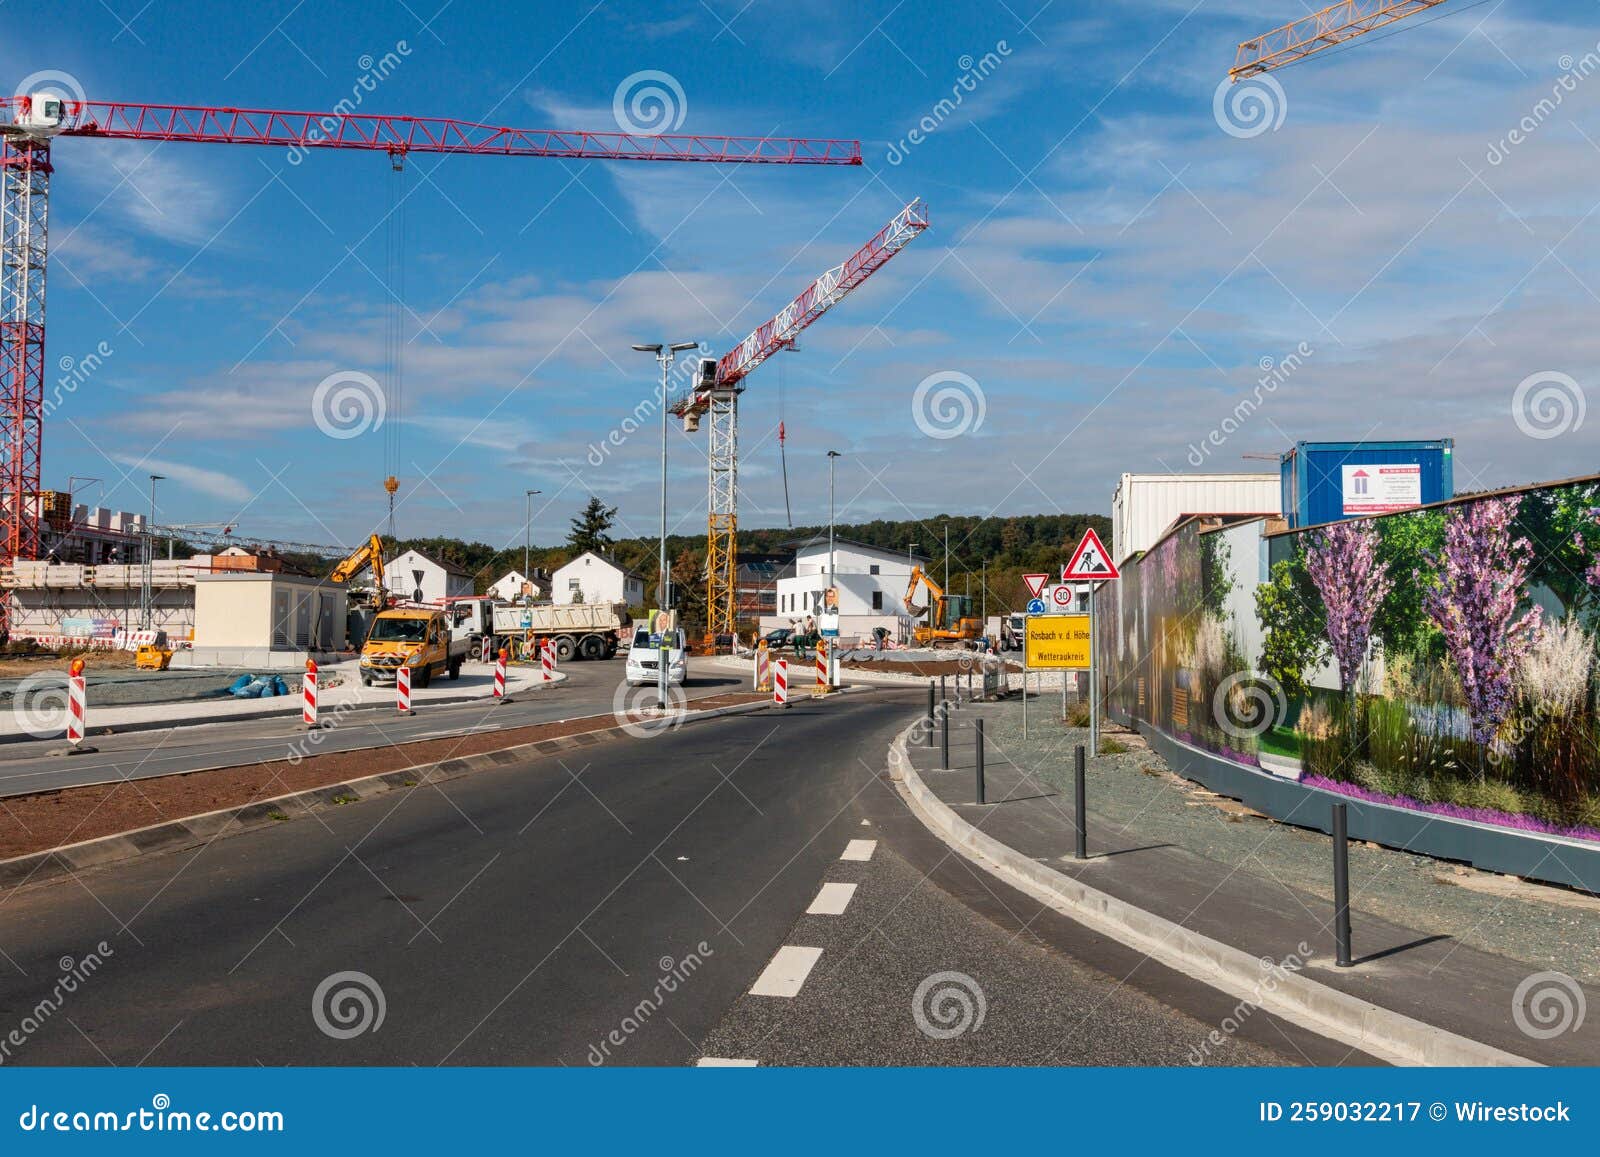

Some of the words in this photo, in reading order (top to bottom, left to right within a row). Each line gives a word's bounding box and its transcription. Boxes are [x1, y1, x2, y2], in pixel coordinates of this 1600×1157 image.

[1057, 592, 1068, 601] 30
[1030, 630, 1056, 640] Rosbach
[1074, 629, 1090, 640] Höhe
[1038, 652, 1085, 661] Wetteraukreis
